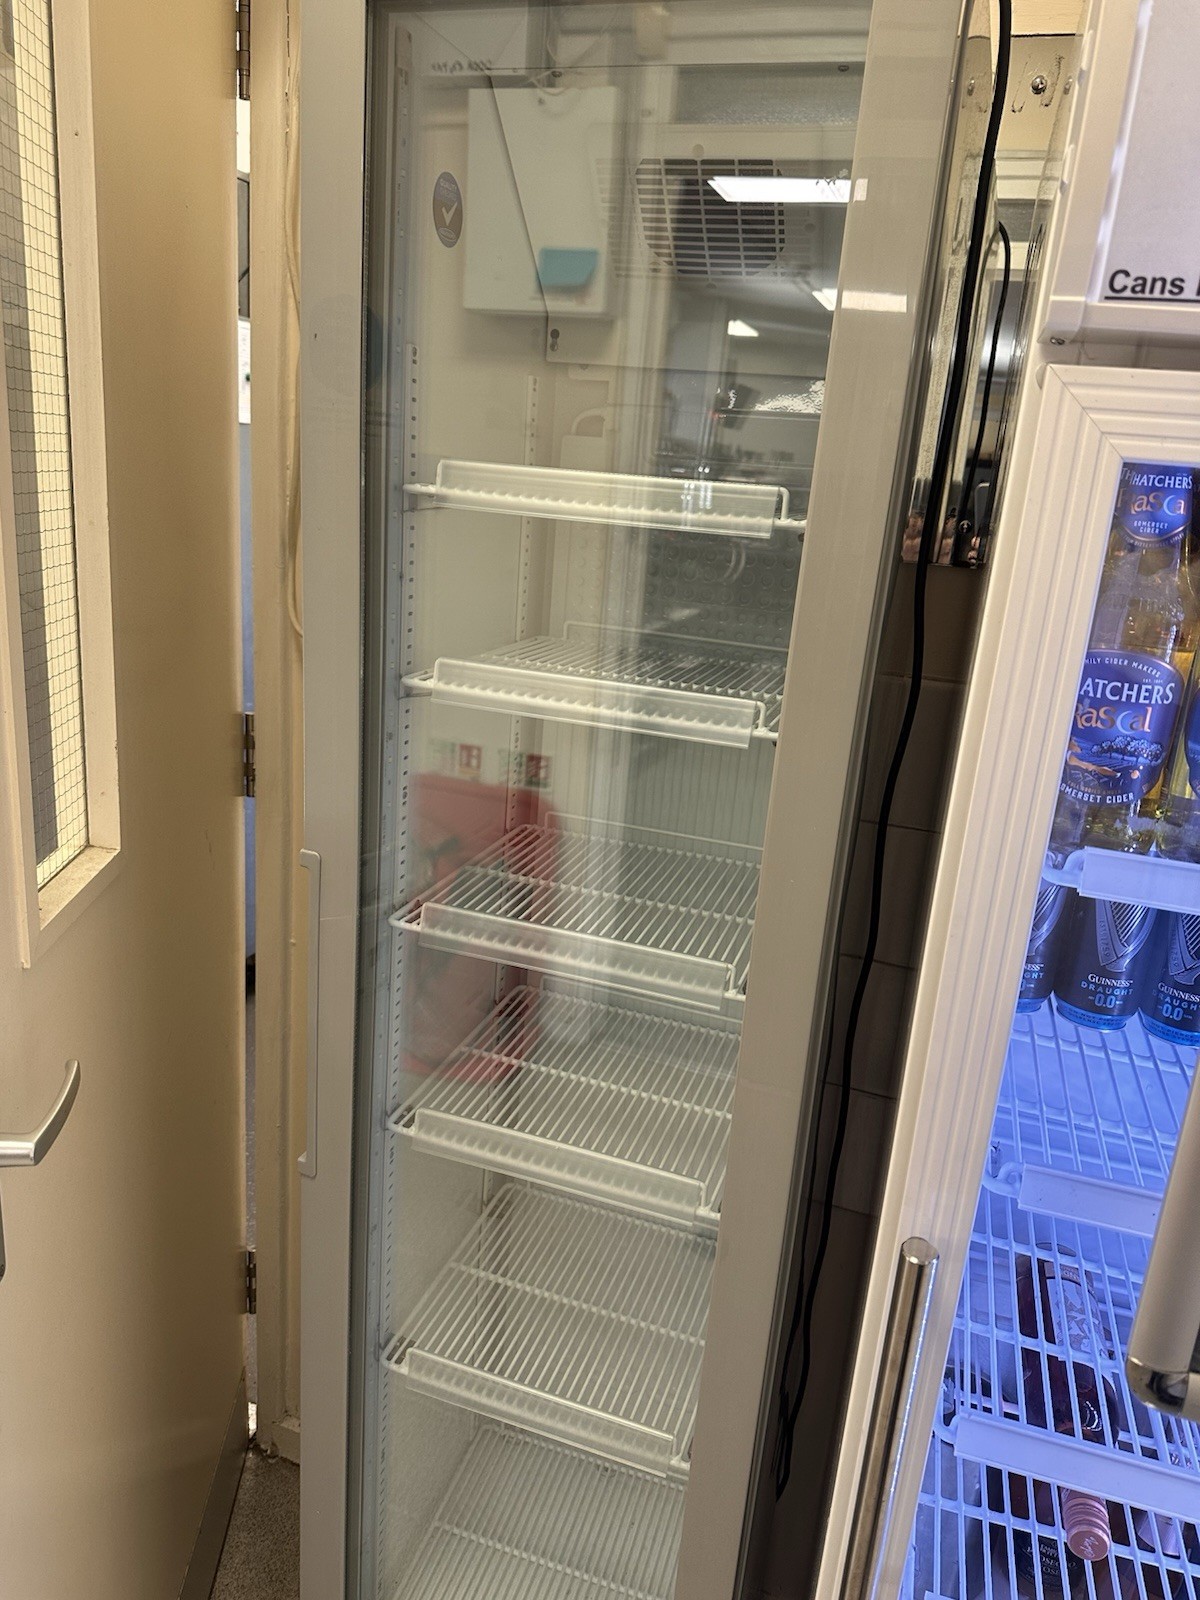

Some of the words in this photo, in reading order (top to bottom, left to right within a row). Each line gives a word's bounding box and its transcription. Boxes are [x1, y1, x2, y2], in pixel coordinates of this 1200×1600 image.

[1108, 269, 1185, 296] Cans
[1133, 520, 1169, 530] SOMERSET
[1139, 527, 1160, 535] CIDER
[1104, 657, 1129, 667] CIDER
[1131, 661, 1162, 678] MAKERS
[1106, 792, 1135, 804] CIDER
[1080, 980, 1134, 996] DRAUGHT
[1087, 973, 1131, 988] GUINNESS
[1157, 982, 1200, 1003] GUINNESS
[1094, 993, 1117, 1009] 0.0
[1162, 1003, 1184, 1021] 0.0
